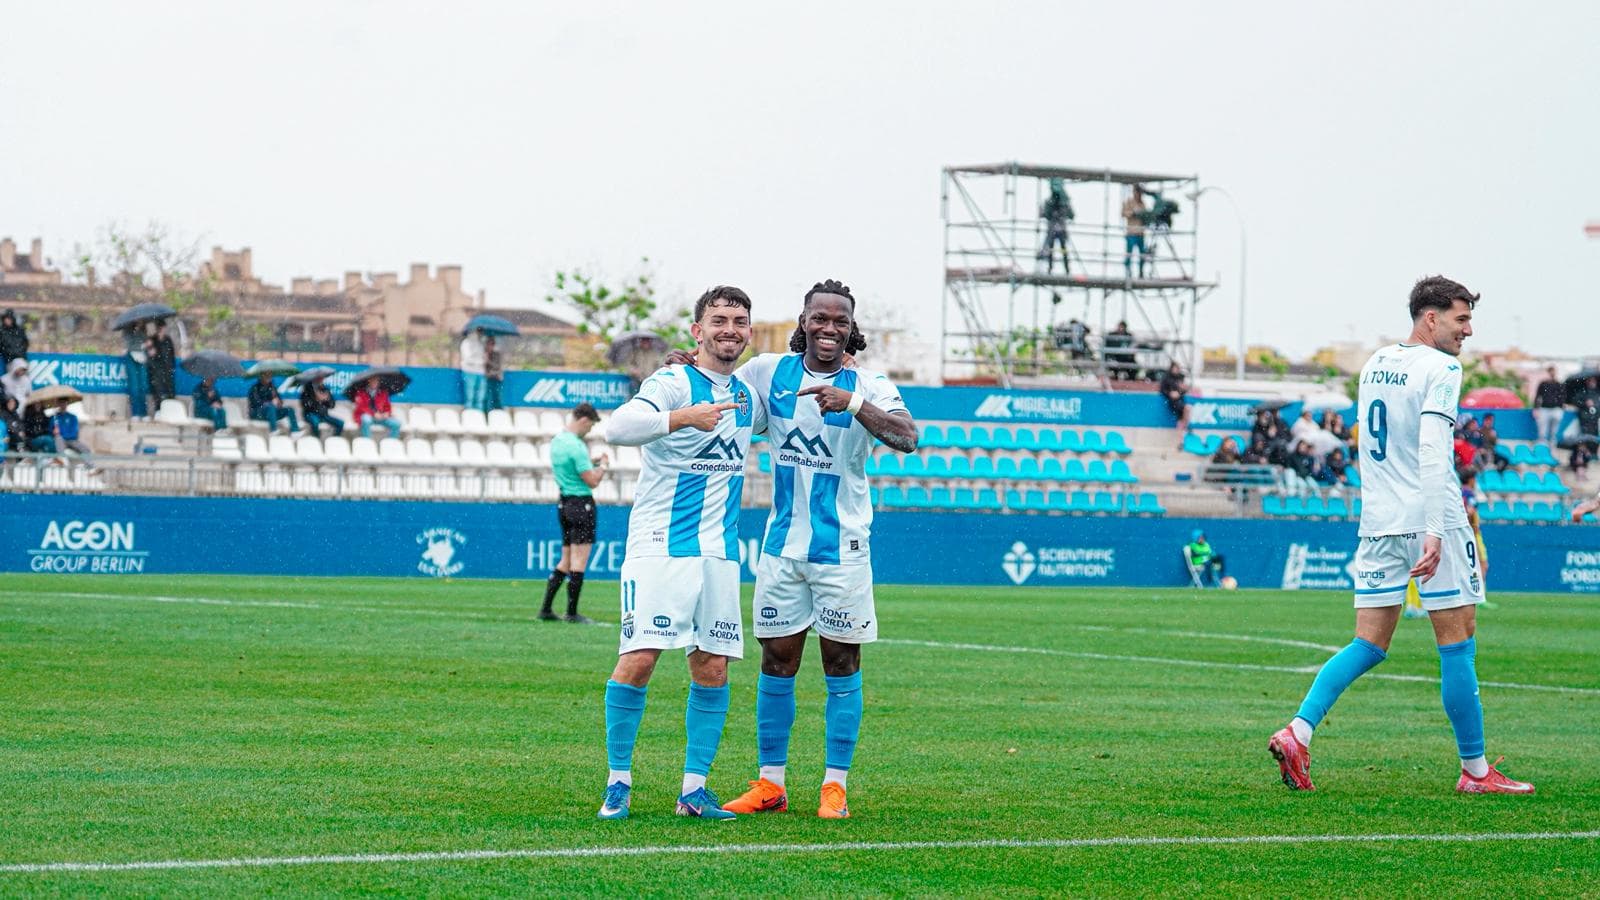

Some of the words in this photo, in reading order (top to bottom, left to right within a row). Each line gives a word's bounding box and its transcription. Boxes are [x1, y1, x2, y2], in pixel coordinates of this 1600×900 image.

[61, 361, 128, 379] MIGUELKA
[1371, 371, 1408, 386] TOVAR
[1368, 399, 1388, 462] 9
[41, 520, 135, 550] AGON
[1466, 541, 1476, 569] 9
[30, 555, 87, 572] GROUP
[91, 556, 144, 573] BERLIN
[1560, 568, 1600, 584] SORD
[623, 579, 636, 613] 11
[819, 614, 852, 629] SORDA
[822, 607, 850, 620] FONT
[715, 620, 738, 631] FONT
[709, 629, 740, 641] SORDA
